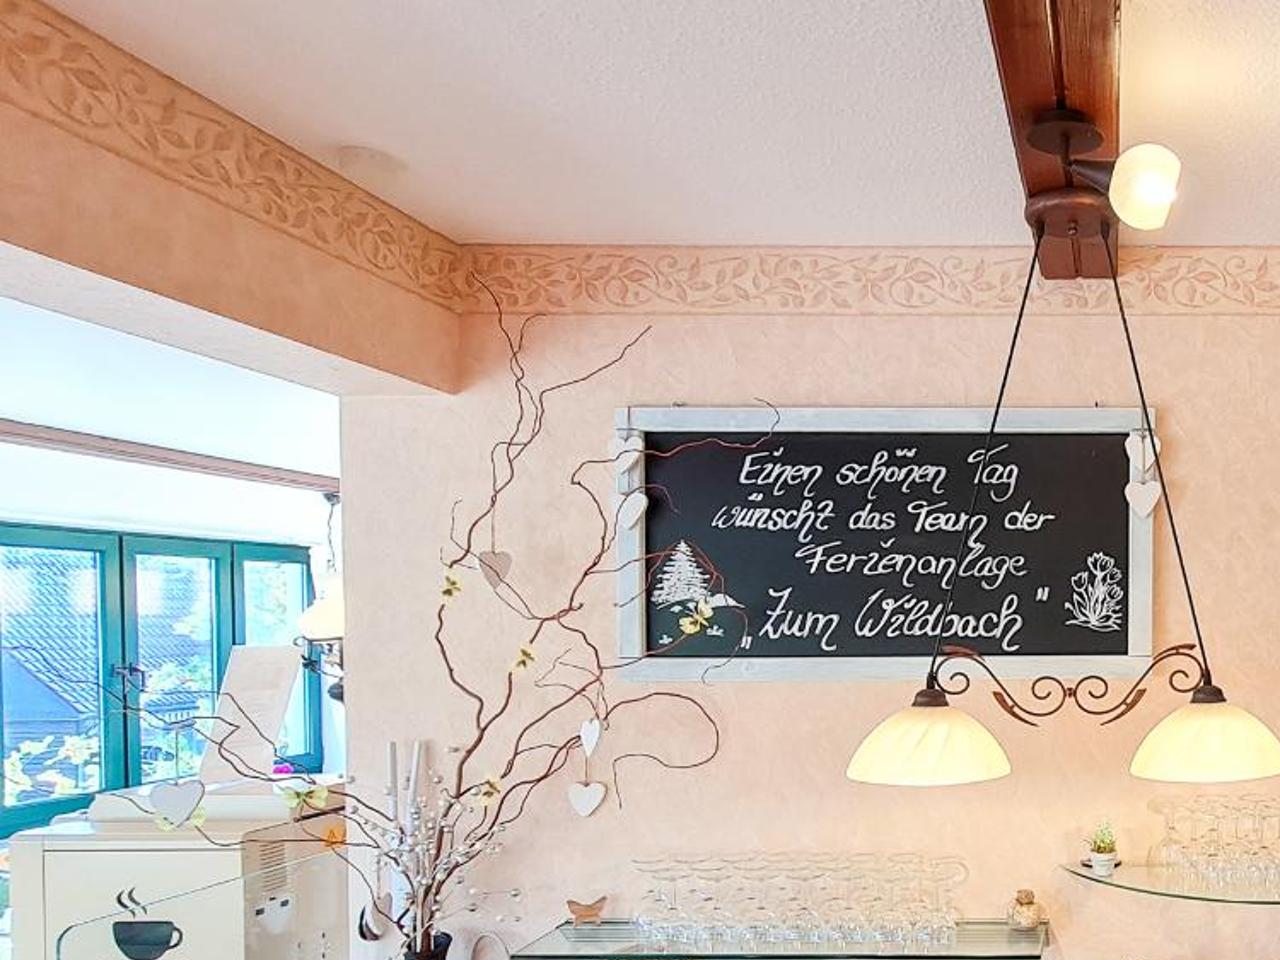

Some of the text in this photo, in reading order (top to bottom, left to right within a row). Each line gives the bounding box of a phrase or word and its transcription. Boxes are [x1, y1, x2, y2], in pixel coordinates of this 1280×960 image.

[739, 443, 1019, 502] Einen schönen Tag
[711, 492, 1056, 549] wünscht das Team der
[794, 538, 1028, 590] Ferienanlage
